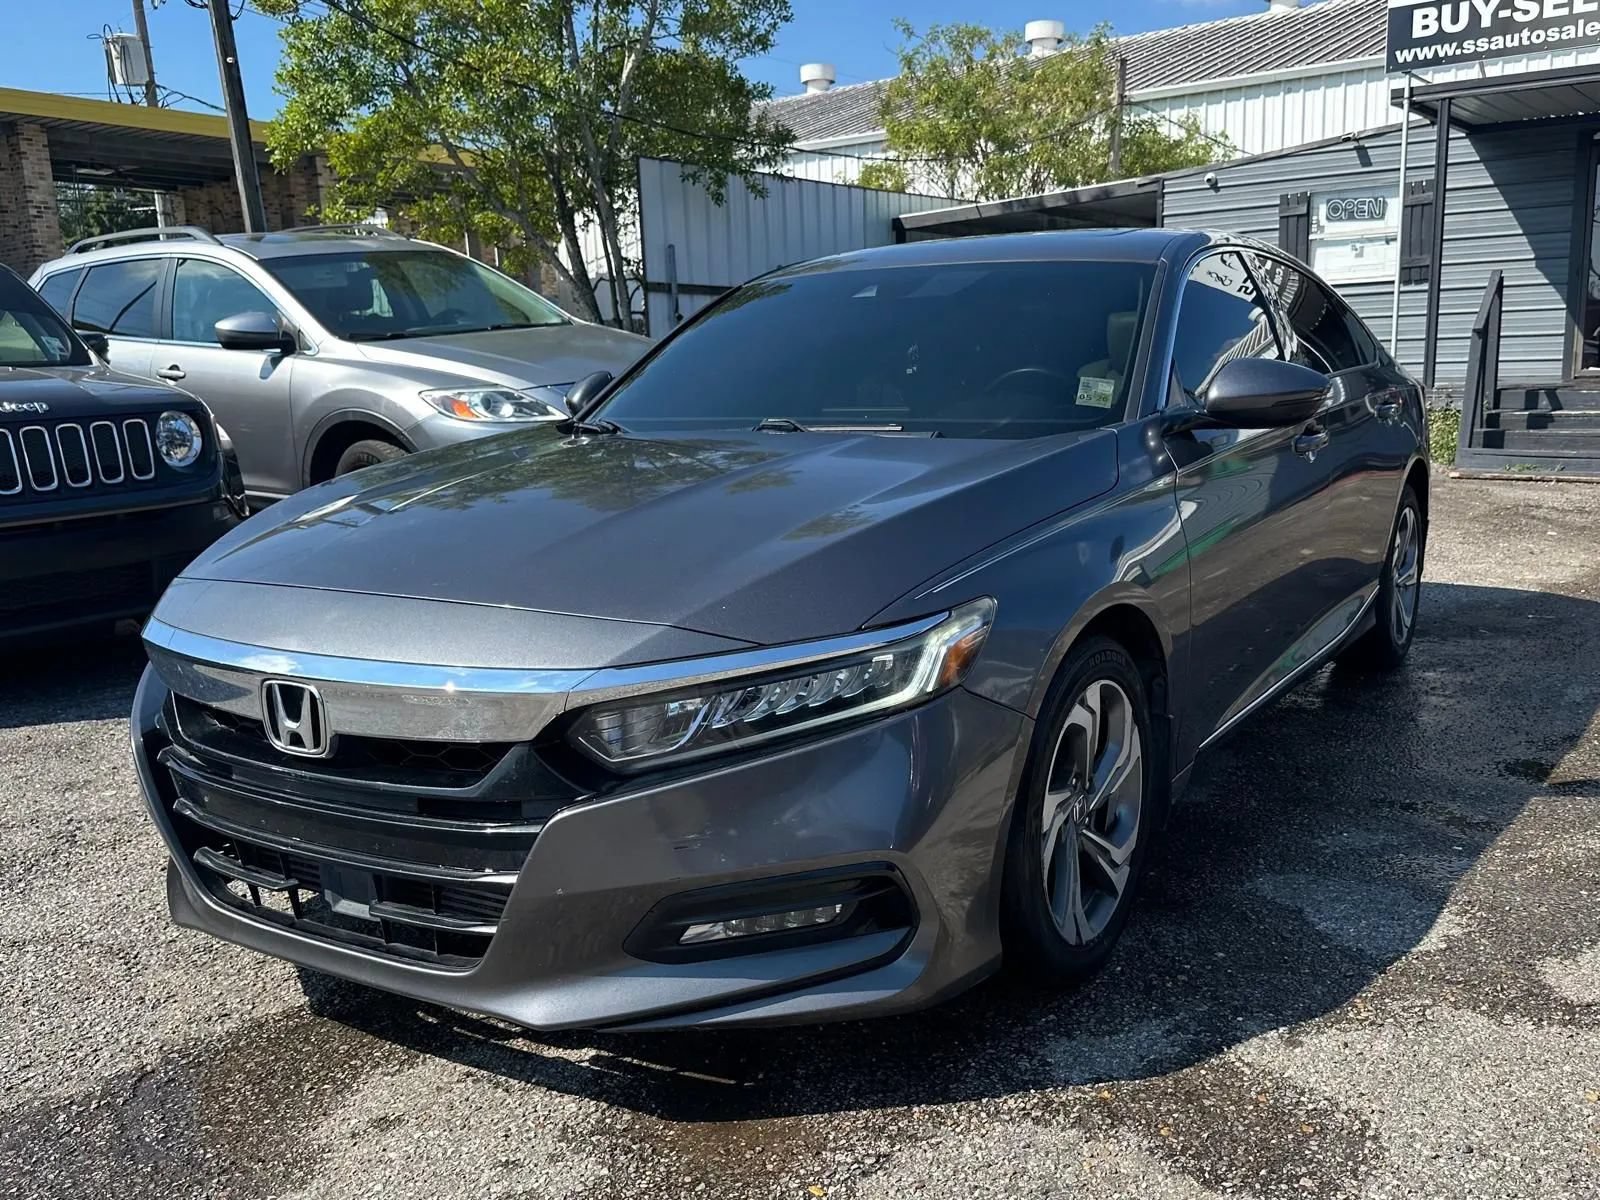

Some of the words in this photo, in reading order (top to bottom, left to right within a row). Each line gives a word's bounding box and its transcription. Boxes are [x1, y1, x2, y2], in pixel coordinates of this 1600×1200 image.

[1395, 19, 1600, 63] www.ssautosale
[1327, 197, 1384, 220] OPEN
[0, 401, 49, 414] Jeep
